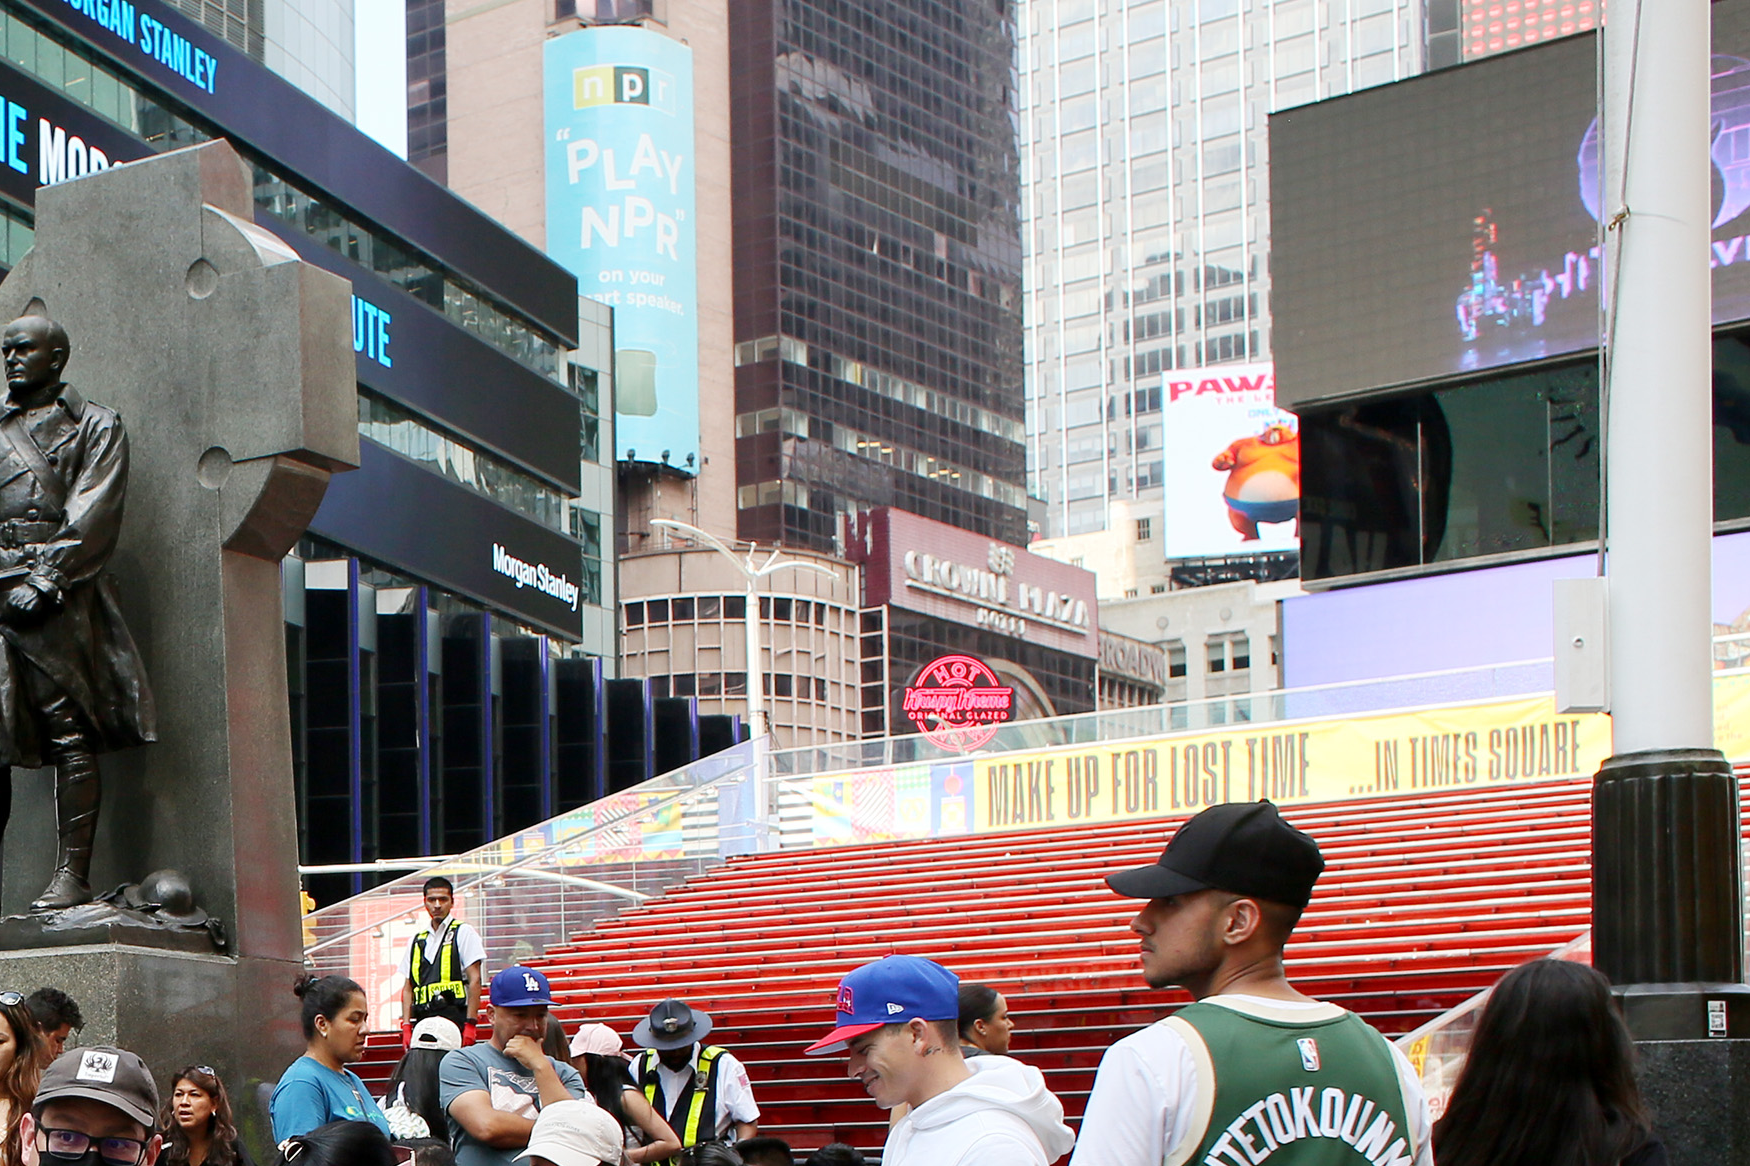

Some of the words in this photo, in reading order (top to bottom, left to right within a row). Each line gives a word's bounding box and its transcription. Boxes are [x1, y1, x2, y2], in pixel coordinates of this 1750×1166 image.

[139, 13, 218, 95] STANLEY
[598, 269, 624, 283] on
[628, 270, 666, 293] your
[492, 542, 537, 589] Morgan
[536, 563, 580, 612] Stanley
[932, 661, 981, 684] HOT
[965, 711, 1010, 720] GLAZED
[1409, 731, 1478, 789] TIMES
[1489, 719, 1581, 782] SQUARE
[987, 759, 1055, 828] MAKE
[1066, 754, 1100, 819] UP
[1111, 748, 1158, 815] FOR
[1170, 740, 1233, 809] LOST
[1246, 731, 1310, 801] TIME
[522, 972, 541, 992] LA
